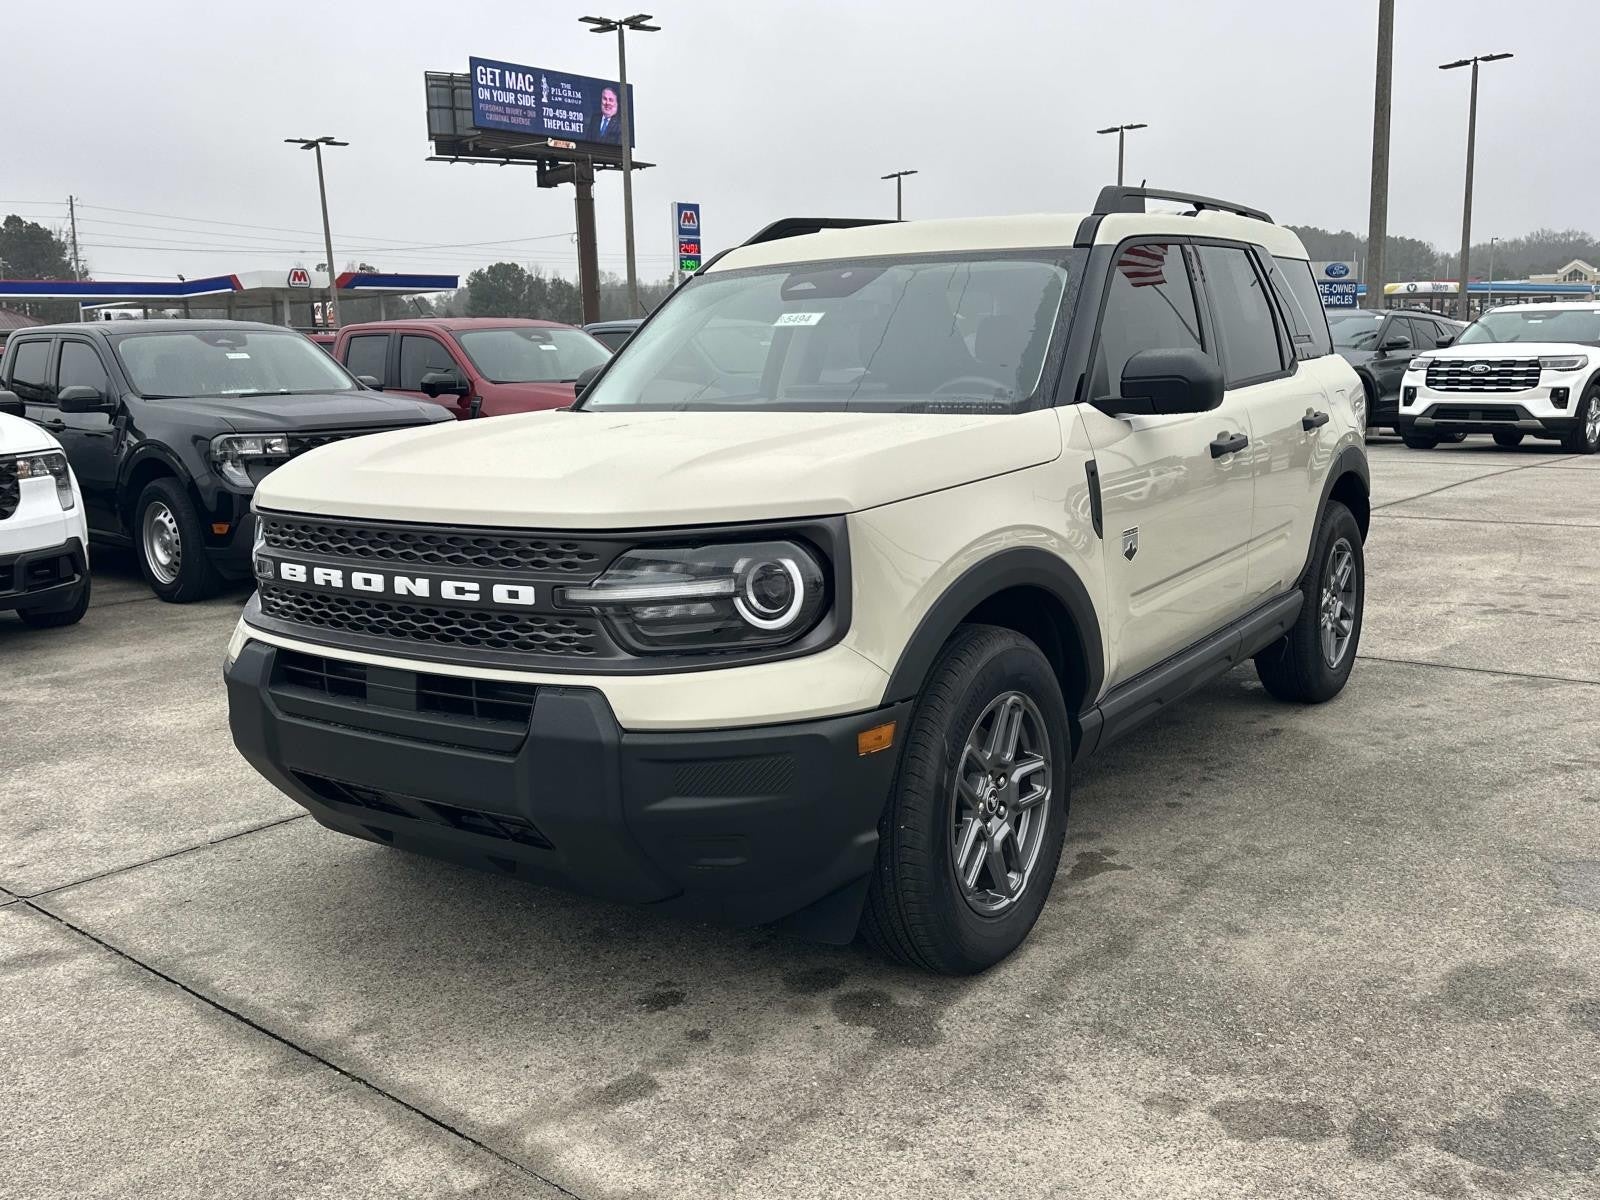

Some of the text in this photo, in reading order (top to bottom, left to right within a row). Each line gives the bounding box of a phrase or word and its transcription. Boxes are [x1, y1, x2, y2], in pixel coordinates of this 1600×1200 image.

[476, 65, 534, 92] GET MAC
[560, 82, 572, 90] THE
[478, 87, 536, 107] ON YOUR SIDE
[551, 87, 582, 99] PILGRIM
[564, 97, 582, 105] GROUP
[479, 103, 504, 113] PERSONAL
[485, 113, 509, 123] CRIMINAL
[542, 106, 583, 122] 770-459-9210
[543, 118, 584, 133] THEPLG.NET
[1328, 265, 1347, 276] Ford
[1318, 283, 1356, 294] RE-OWNED
[1432, 283, 1449, 292] Valero
[1322, 295, 1353, 305] EHICLES
[1472, 365, 1488, 373] Ford
[280, 562, 536, 606] BRONCO
